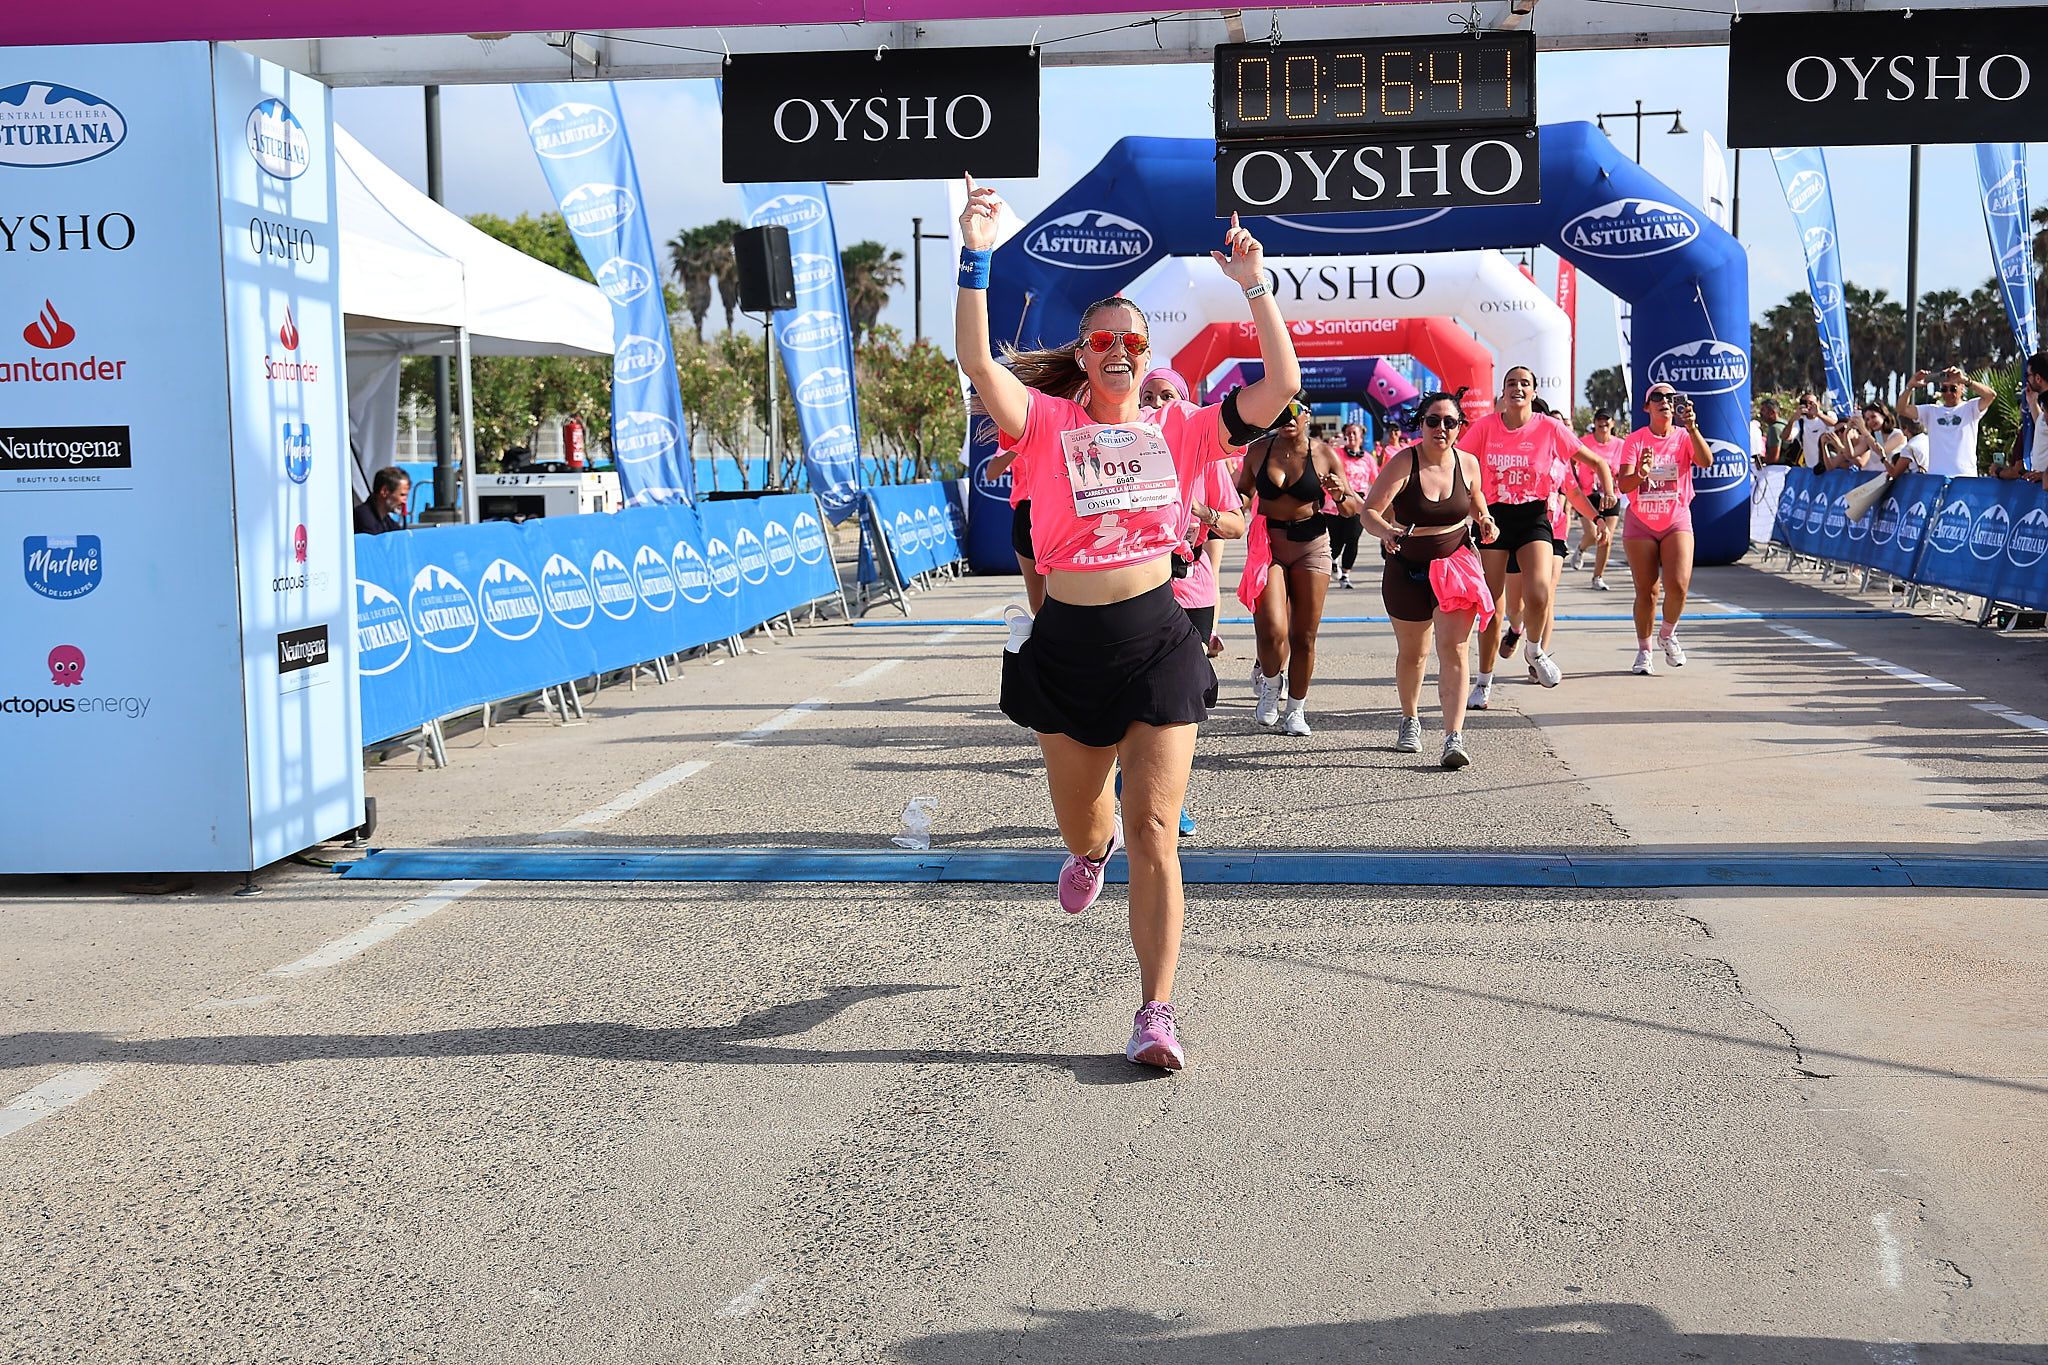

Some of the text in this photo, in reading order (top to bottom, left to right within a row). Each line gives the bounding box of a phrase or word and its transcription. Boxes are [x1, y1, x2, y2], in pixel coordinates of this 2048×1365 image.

[1237, 49, 1511, 121] 00:36:41
[1786, 54, 2031, 102] OYSHO
[51, 110, 107, 119] LECHERA
[773, 94, 992, 143] OYSHO
[0, 122, 115, 145] TURIANA
[251, 120, 305, 166] ASTURIANA
[1231, 140, 1523, 205] OYSHO
[1591, 214, 1684, 230] CENTRAL LECHERA
[249, 217, 314, 264] OYSHO
[1032, 231, 1142, 255] ASTURIANA
[1053, 229, 1095, 237] CENTRAL
[1573, 226, 1692, 247] ASTURIANA
[1145, 311, 1187, 323] YSHO
[1480, 301, 1536, 313] OYSHO
[1315, 318, 1399, 334] Santander
[265, 355, 319, 383] Santander
[1655, 361, 1744, 382] ASTURIANA
[1072, 433, 1092, 443] SUMA
[1098, 434, 1135, 444] ASTURIANA
[0, 436, 121, 464] Neutrogena
[1487, 454, 1529, 467] CARRERA
[1103, 459, 1142, 477] 016
[1508, 470, 1522, 485] DE
[1692, 461, 1743, 479] URIANA
[1116, 476, 1135, 485] 6949
[1084, 489, 1109, 498] CARRERA
[1088, 498, 1121, 510] OYSHO
[1139, 494, 1168, 503] Santander
[1638, 502, 1670, 514] MUJER
[29, 549, 98, 583] Marlene
[33, 581, 48, 593] HIJA
[73, 582, 93, 596] ALPES
[272, 571, 305, 594] octopus
[485, 591, 539, 623] ASTURIANA
[546, 583, 592, 613] ASTURIANA
[418, 605, 475, 634] ASTURIANA
[281, 638, 327, 664] Neutrogena
[78, 697, 151, 719] energy
